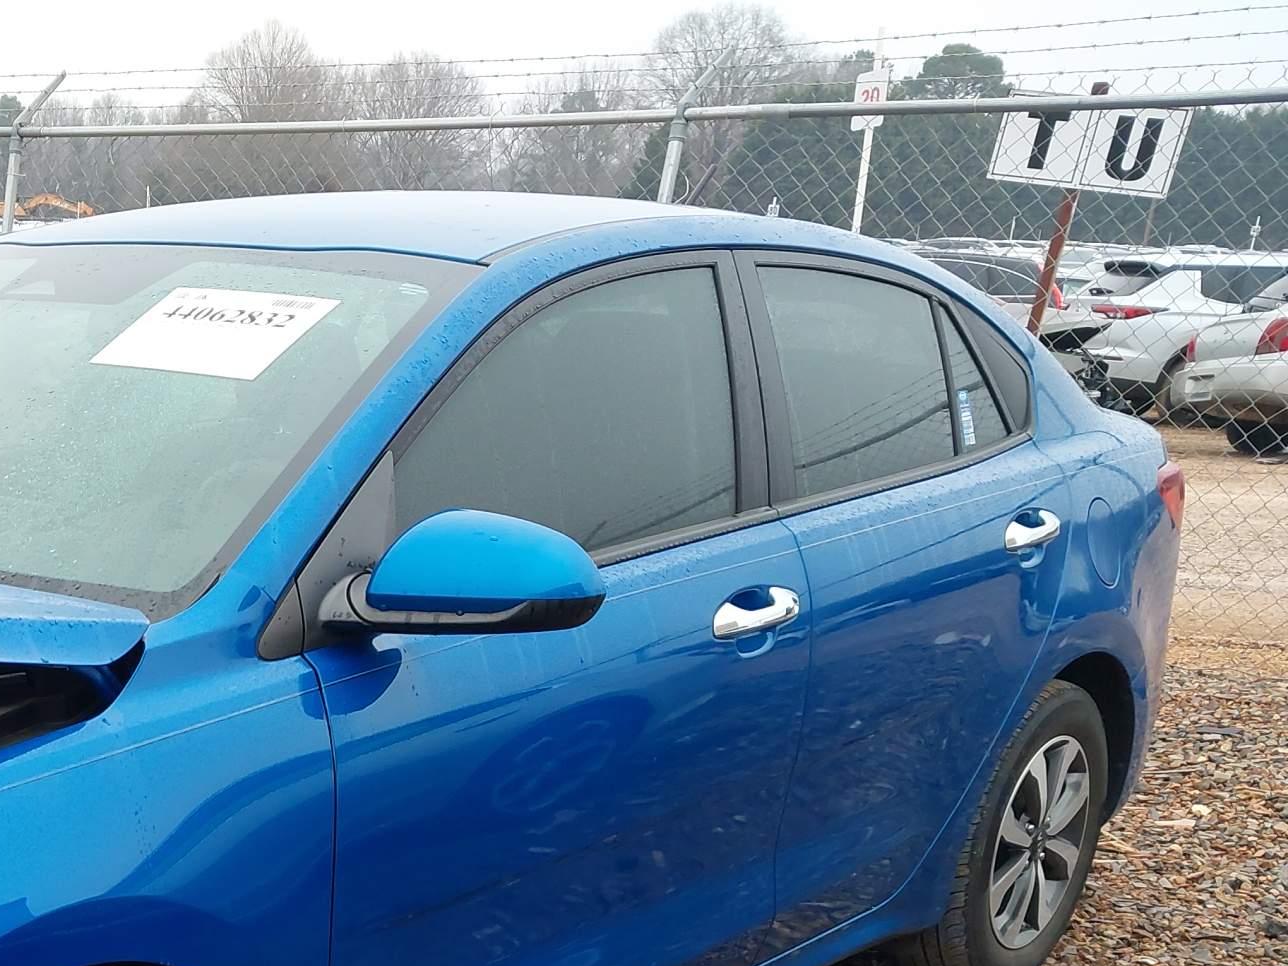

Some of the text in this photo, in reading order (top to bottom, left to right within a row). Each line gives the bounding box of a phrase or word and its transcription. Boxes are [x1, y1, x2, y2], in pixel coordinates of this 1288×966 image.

[1027, 110, 1165, 181] T U
[162, 304, 295, 328] 44062832
